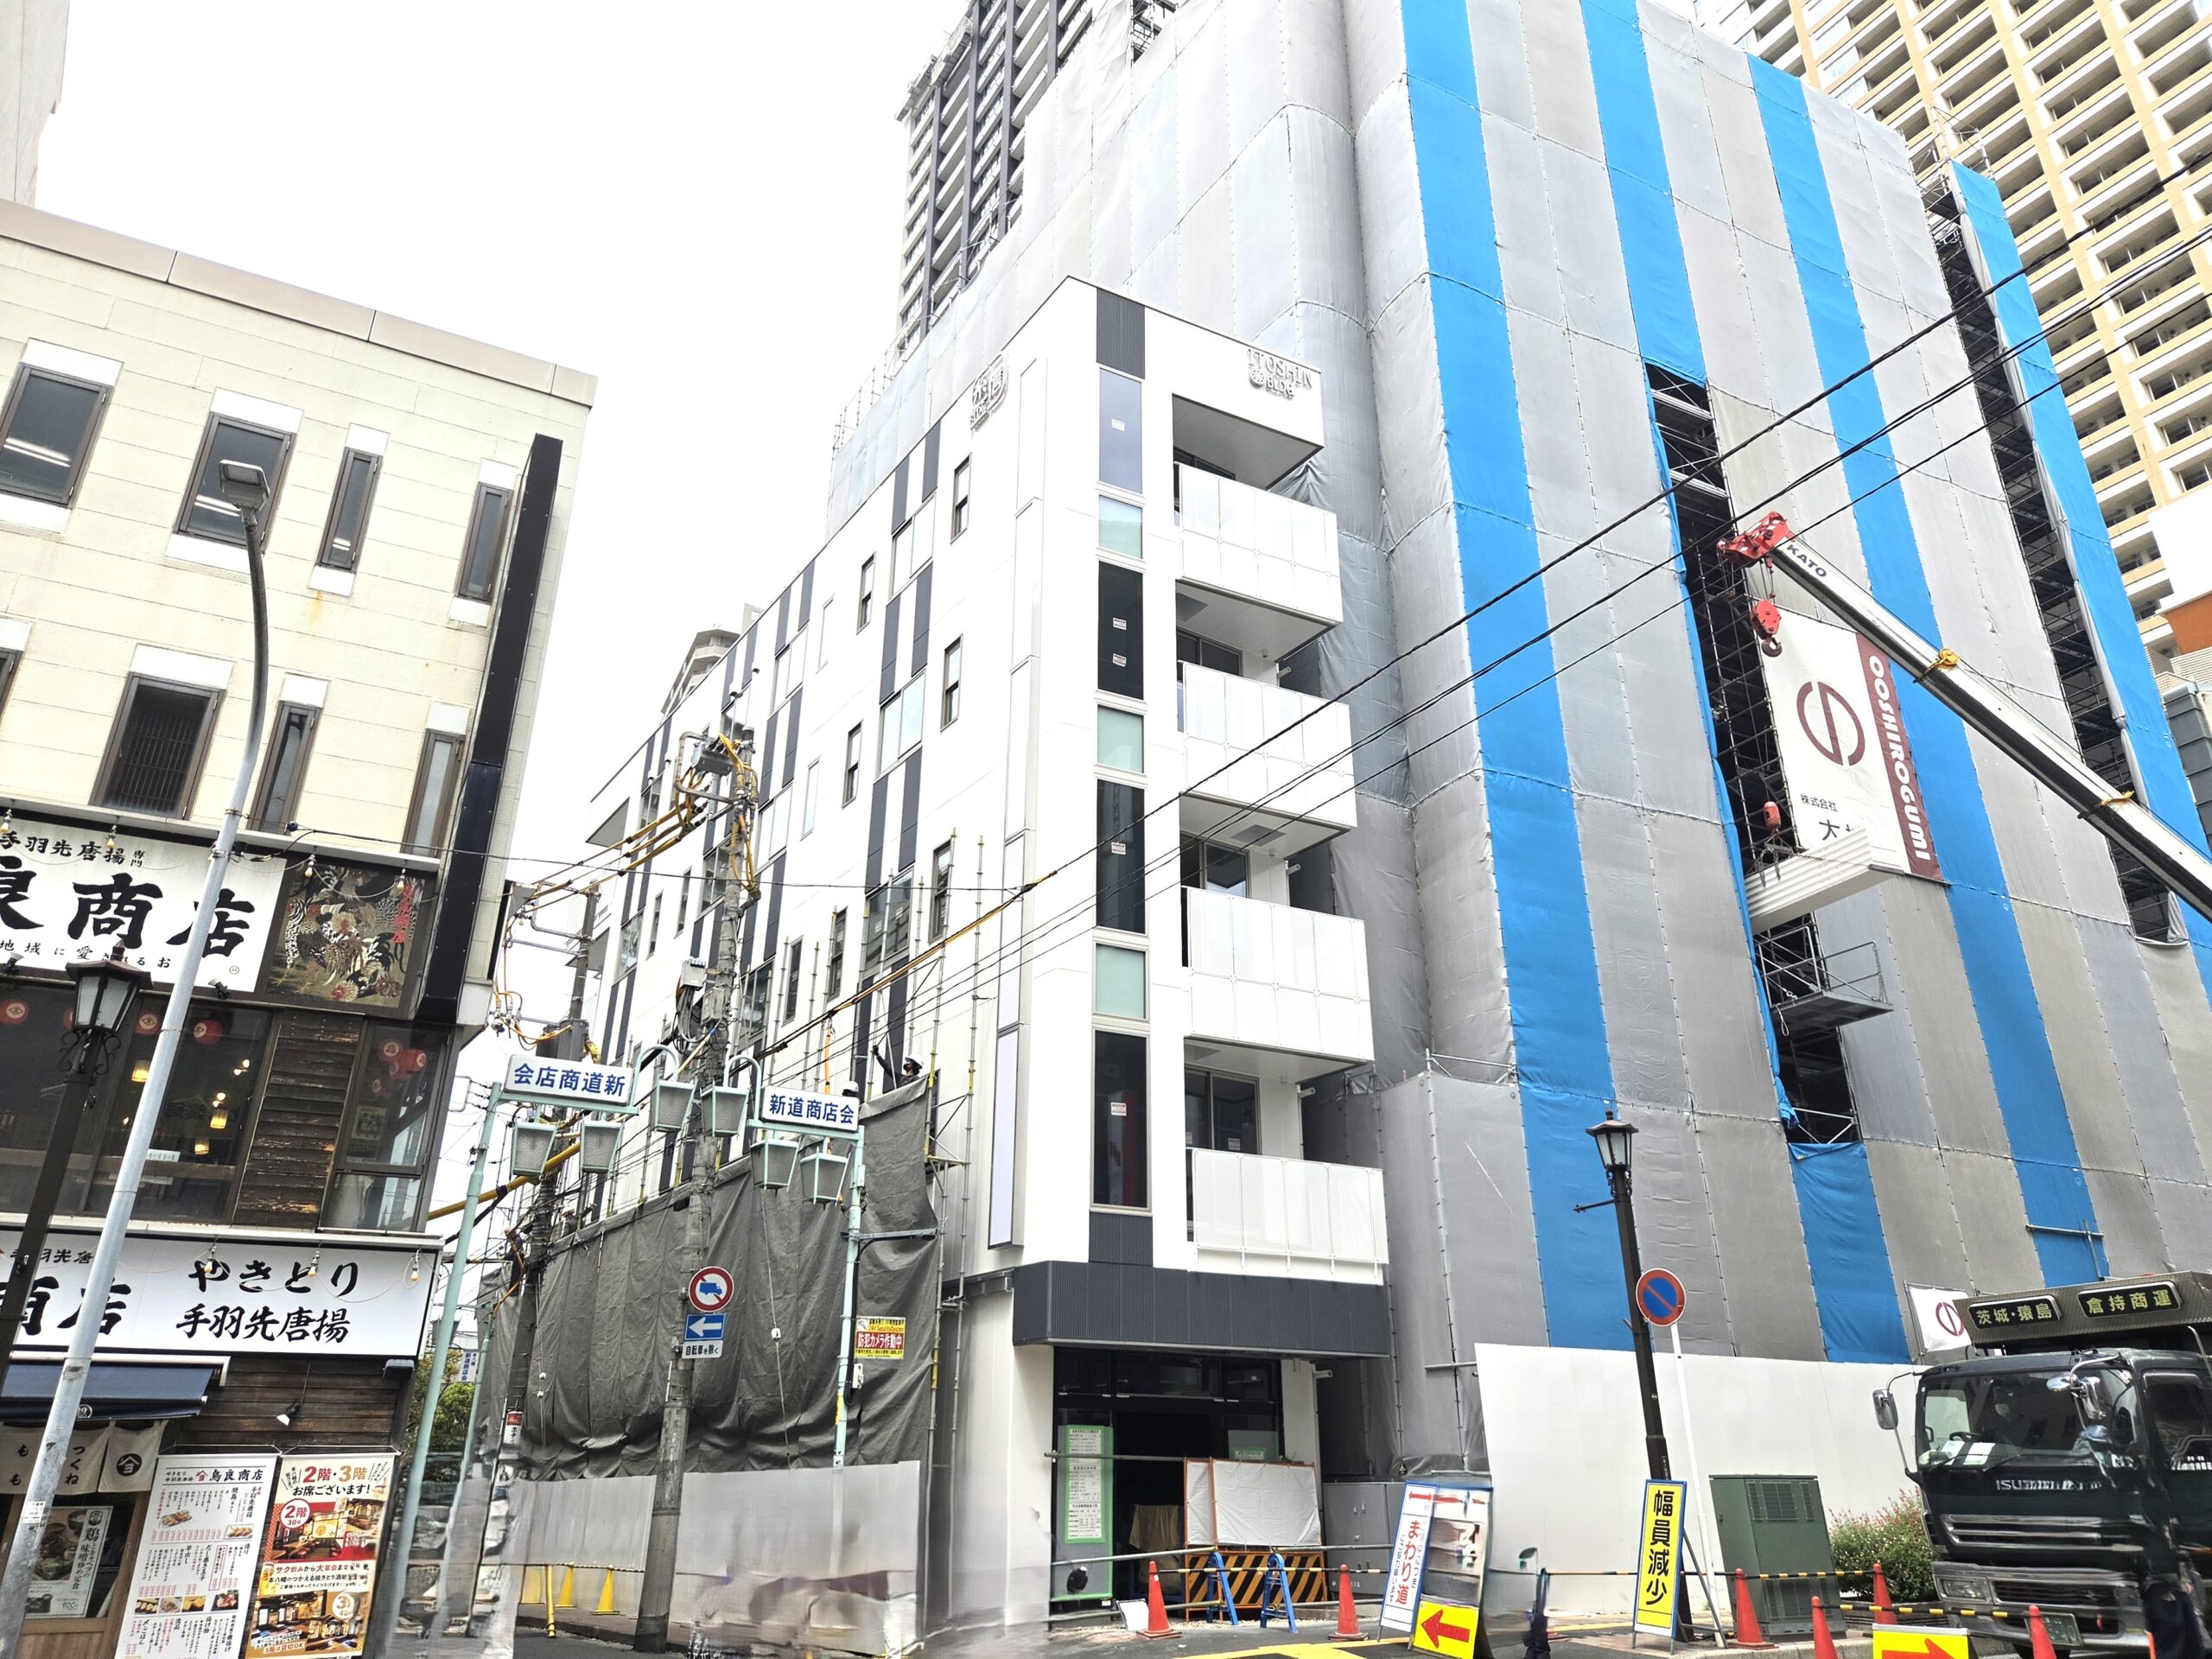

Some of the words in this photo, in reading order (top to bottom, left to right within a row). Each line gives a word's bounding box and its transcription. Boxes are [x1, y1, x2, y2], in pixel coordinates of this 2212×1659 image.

[1786, 543, 1827, 578] KATO
[1869, 655, 1932, 861] OOSHIROGUMI
[1800, 793, 1839, 812] 株式会社
[0, 938, 172, 969] 地域に愛さるお
[769, 1093, 855, 1124] 新道商店会
[188, 1259, 359, 1298] やきとり
[2085, 1289, 2172, 1316] 倉持商運
[175, 1304, 350, 1344] 手羽先唐揚
[685, 1344, 719, 1356] 自転車を除く
[65, 1446, 86, 1485] つくね
[284, 1505, 308, 1518] 2階
[1396, 1520, 1420, 1605] まわり道
[1646, 1491, 1675, 1605] 幅員減少
